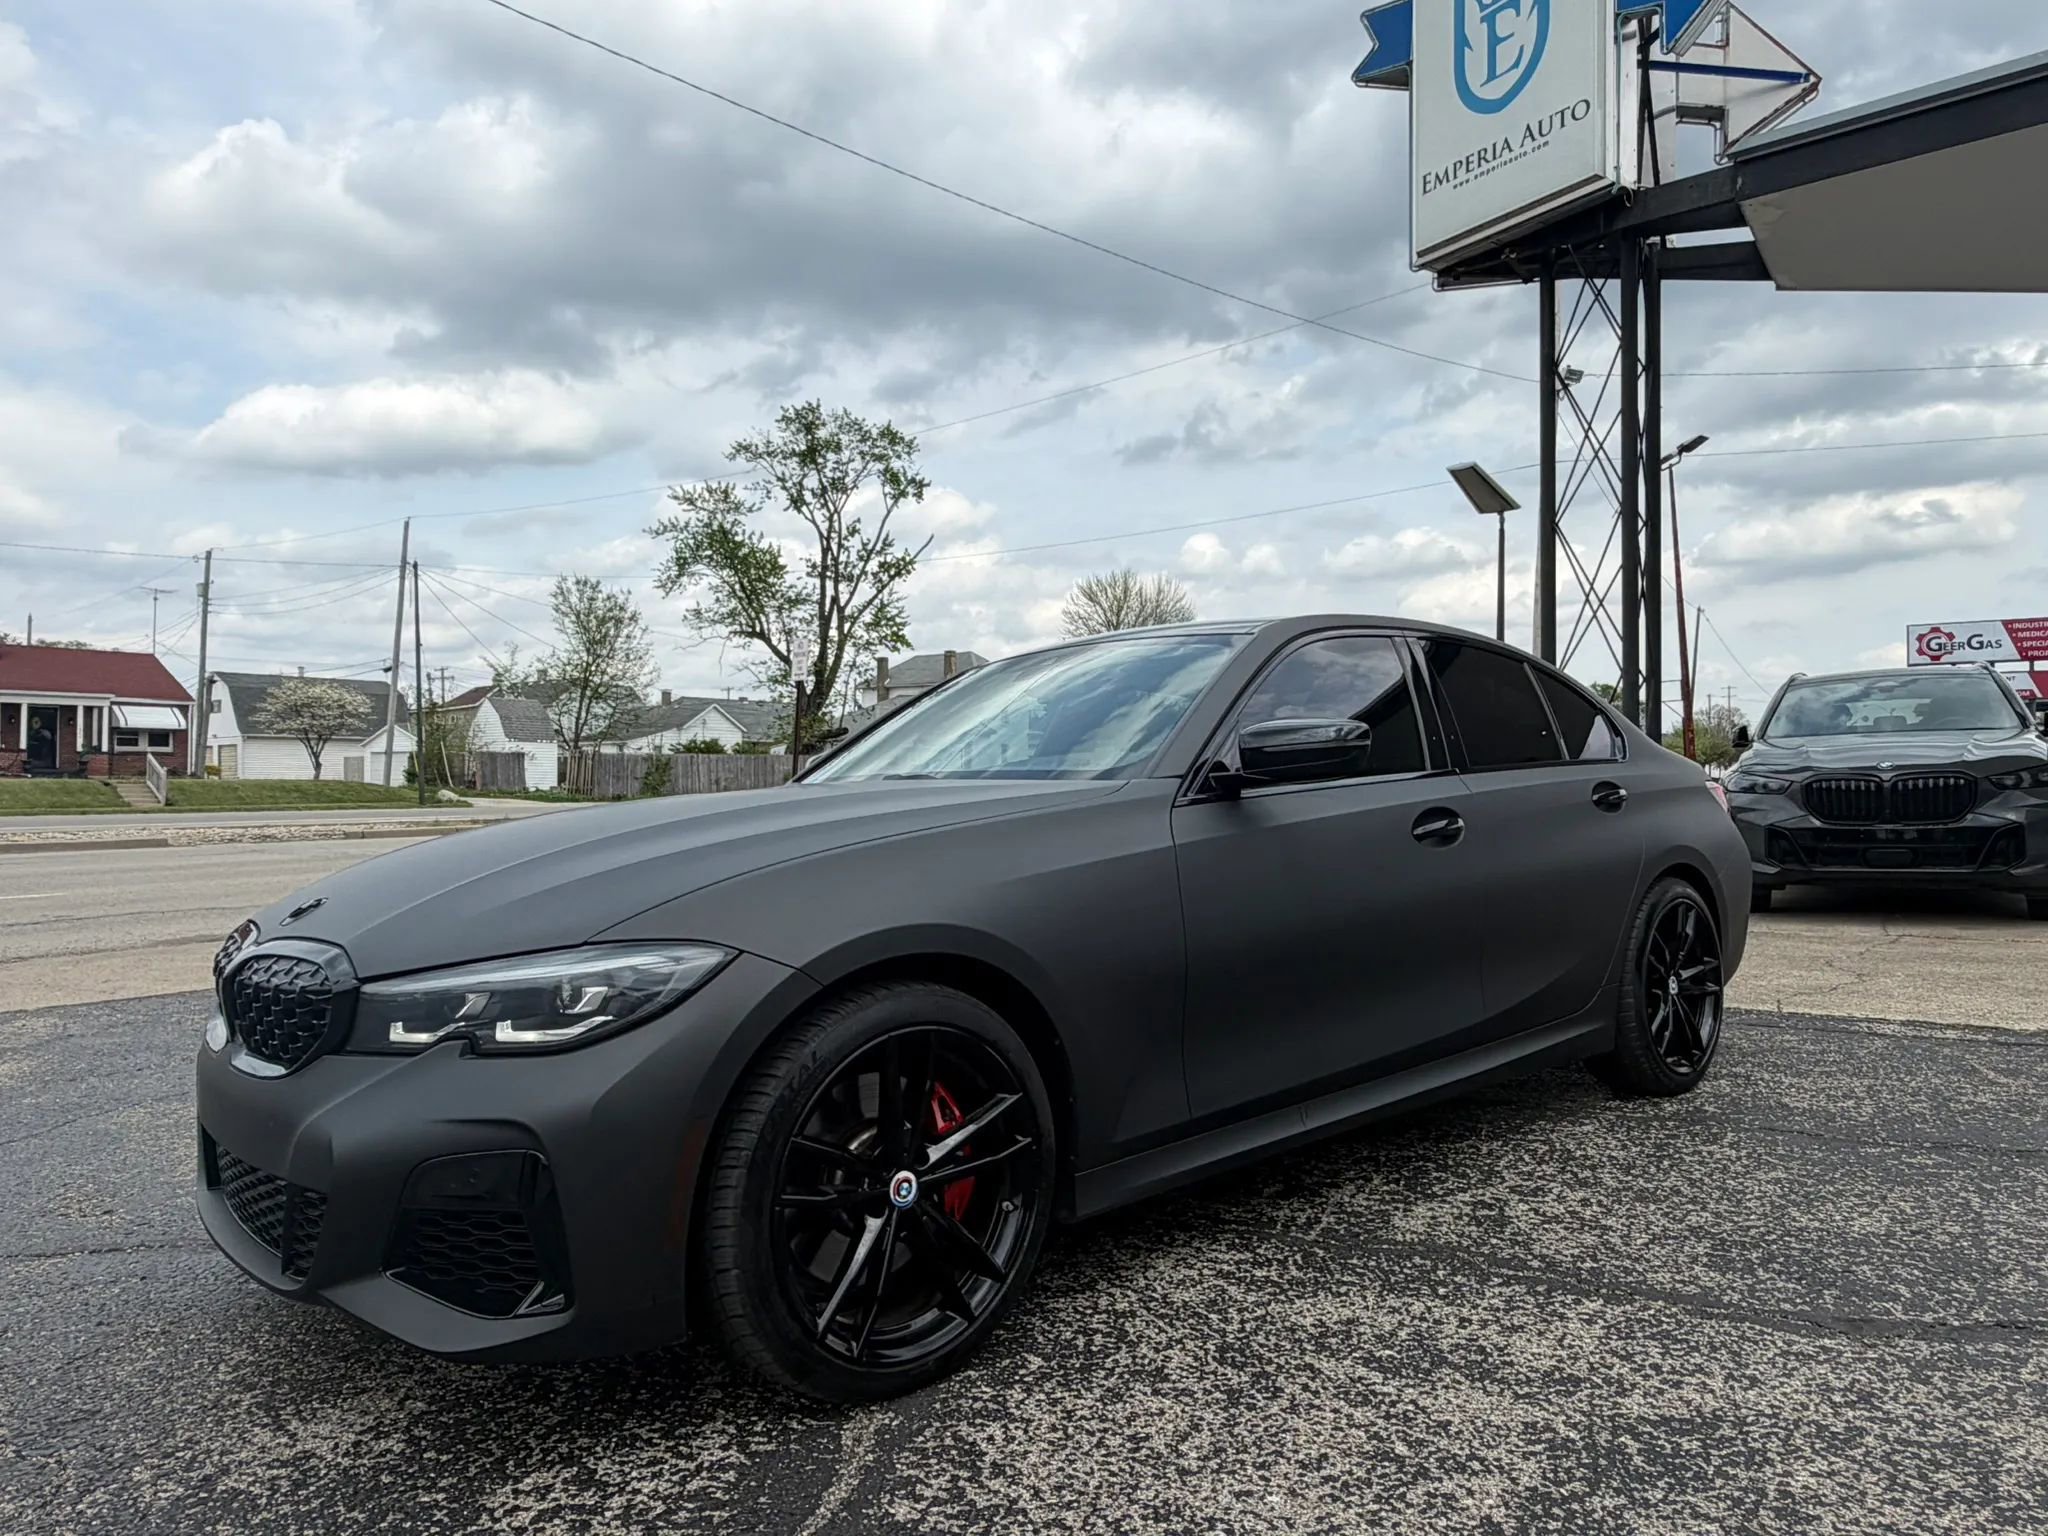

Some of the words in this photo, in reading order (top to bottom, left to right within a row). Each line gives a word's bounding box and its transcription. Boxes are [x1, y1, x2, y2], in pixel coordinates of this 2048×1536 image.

[1421, 136, 1514, 196] EMPERIA
[1519, 99, 1591, 148] AUTO
[1453, 140, 1550, 190] www.emperiaauto.com
